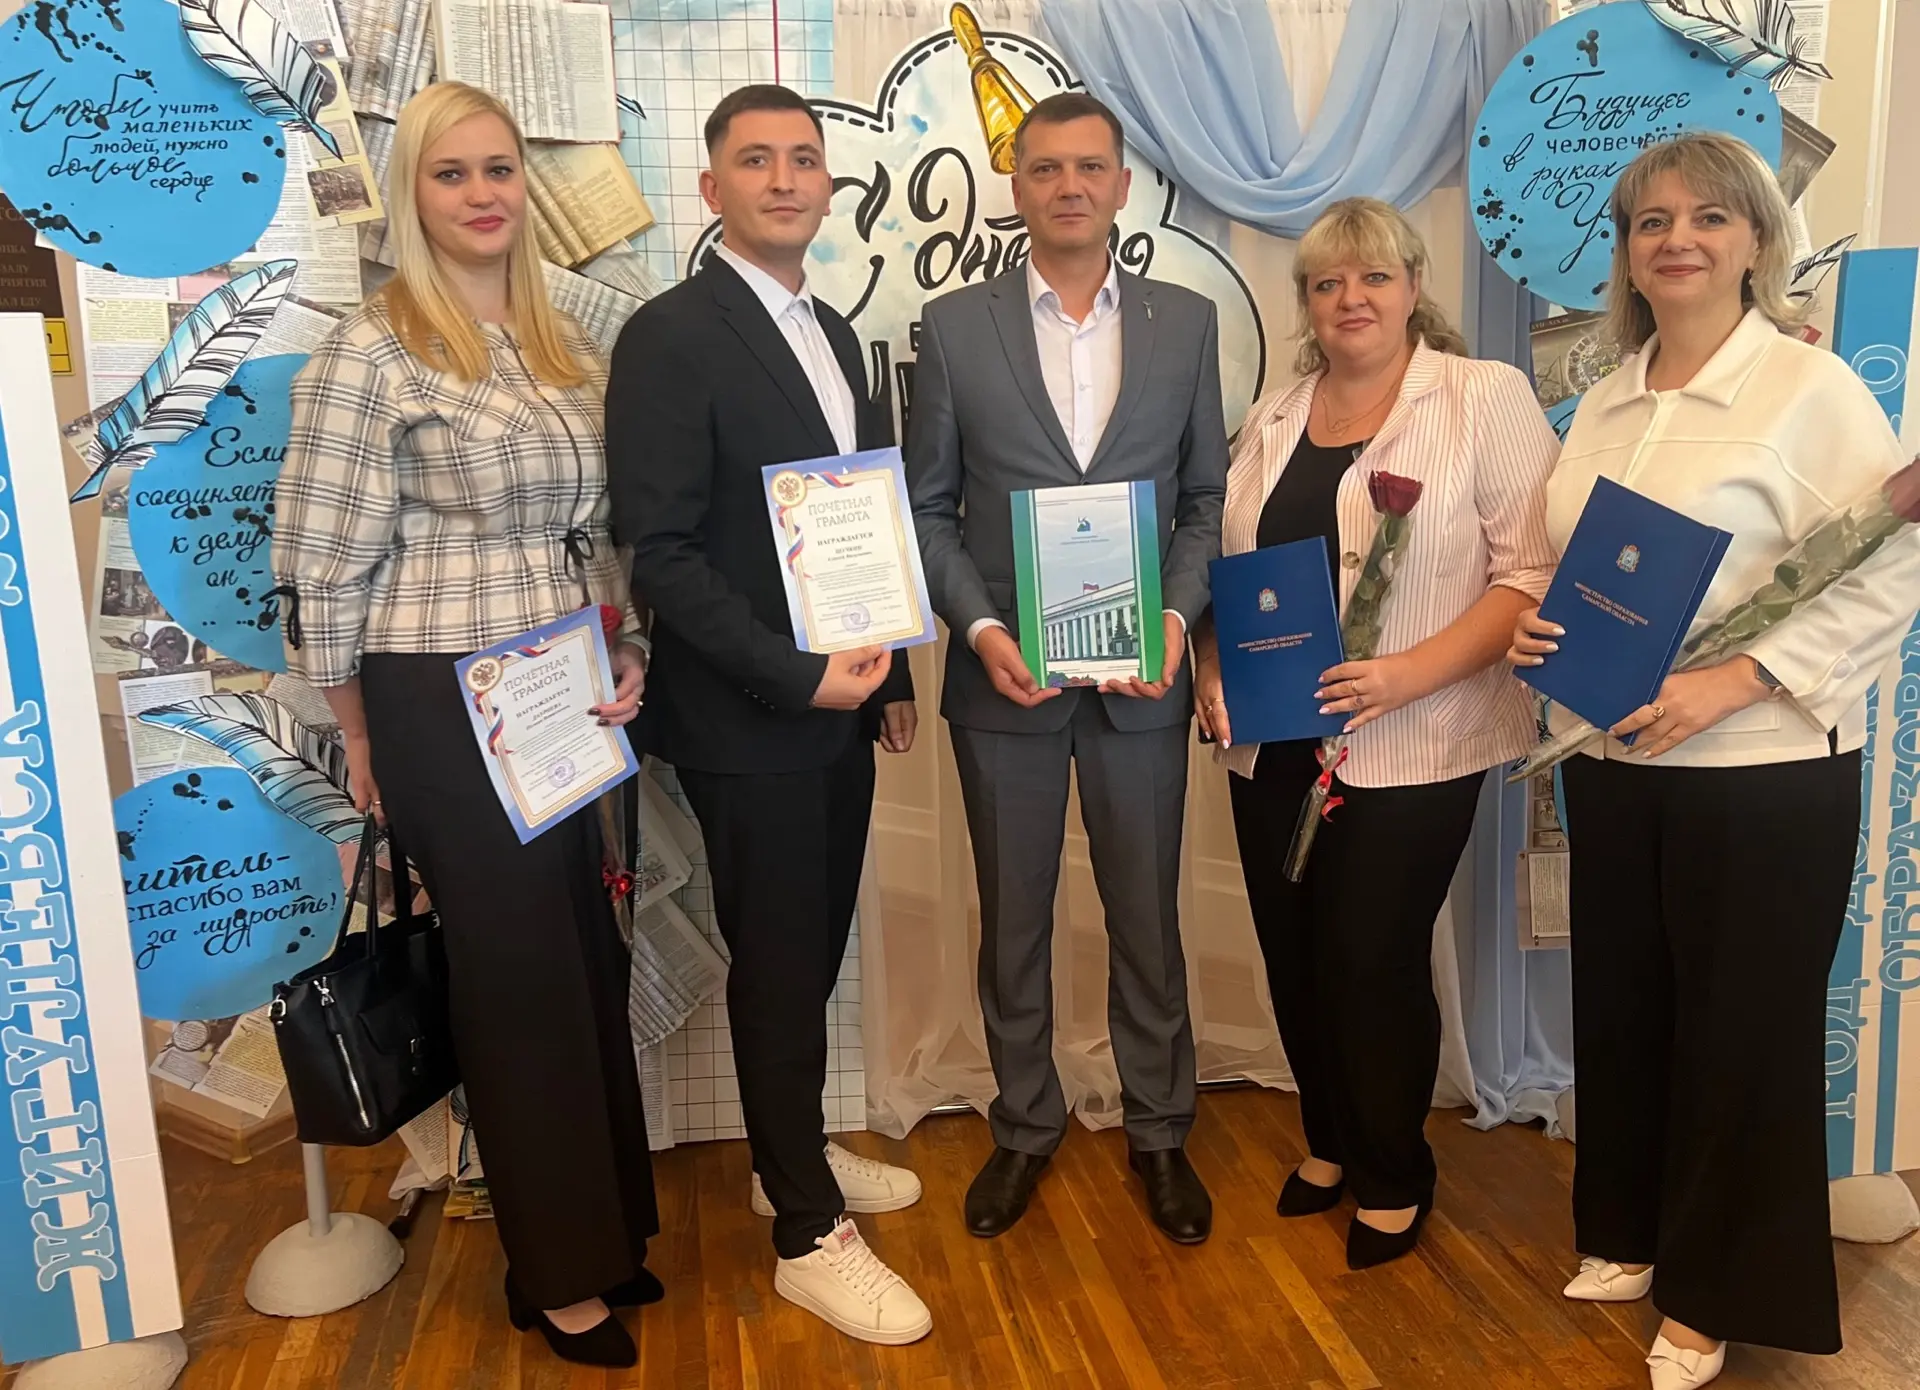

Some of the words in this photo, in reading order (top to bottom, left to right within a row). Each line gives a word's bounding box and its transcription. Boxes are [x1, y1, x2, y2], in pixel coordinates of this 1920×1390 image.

[158, 103, 220, 118] учить
[1530, 70, 1691, 131] Будущее
[121, 118, 253, 134] маленьких
[47, 132, 186, 184] большое
[90, 137, 160, 155] людей,
[165, 139, 229, 156] нужно
[1503, 133, 1534, 173] в
[150, 172, 215, 203] сердце
[1521, 160, 1631, 200] руках
[204, 426, 287, 468] Если
[136, 477, 276, 519] соединяет
[816, 511, 871, 528] ГРАМОТА
[169, 535, 189, 554] к
[193, 529, 267, 565] делу
[817, 531, 874, 547] НАГРАЖДАЕТСЯ
[206, 569, 239, 588] он
[512, 669, 568, 701] ГРАМОТА
[516, 687, 571, 718] НАГРАЖДАЕТСЯ
[252, 876, 303, 900] вам
[136, 927, 178, 970] за
[193, 892, 338, 957] мудрость!
